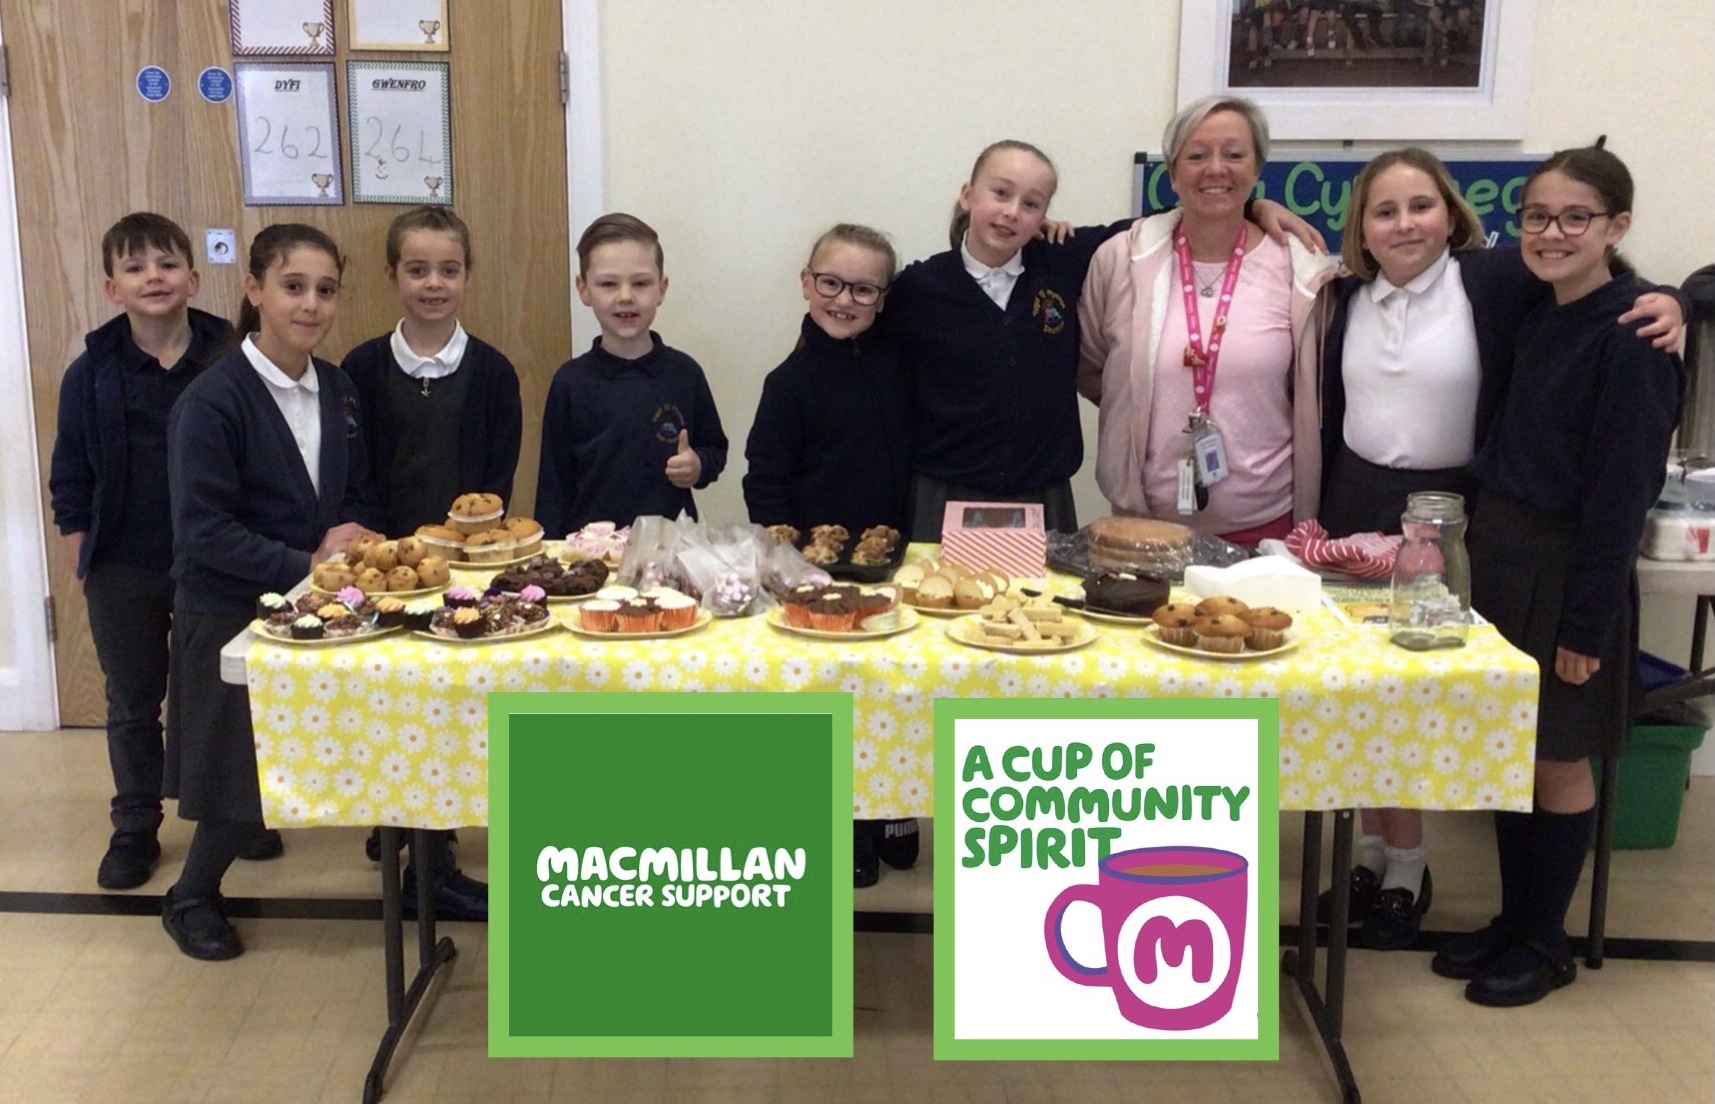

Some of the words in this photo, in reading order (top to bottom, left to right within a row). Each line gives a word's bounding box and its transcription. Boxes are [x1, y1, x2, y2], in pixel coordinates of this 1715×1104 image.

[274, 78, 301, 91] DYFI
[372, 78, 427, 91] GWENFRO
[254, 116, 328, 160] 262
